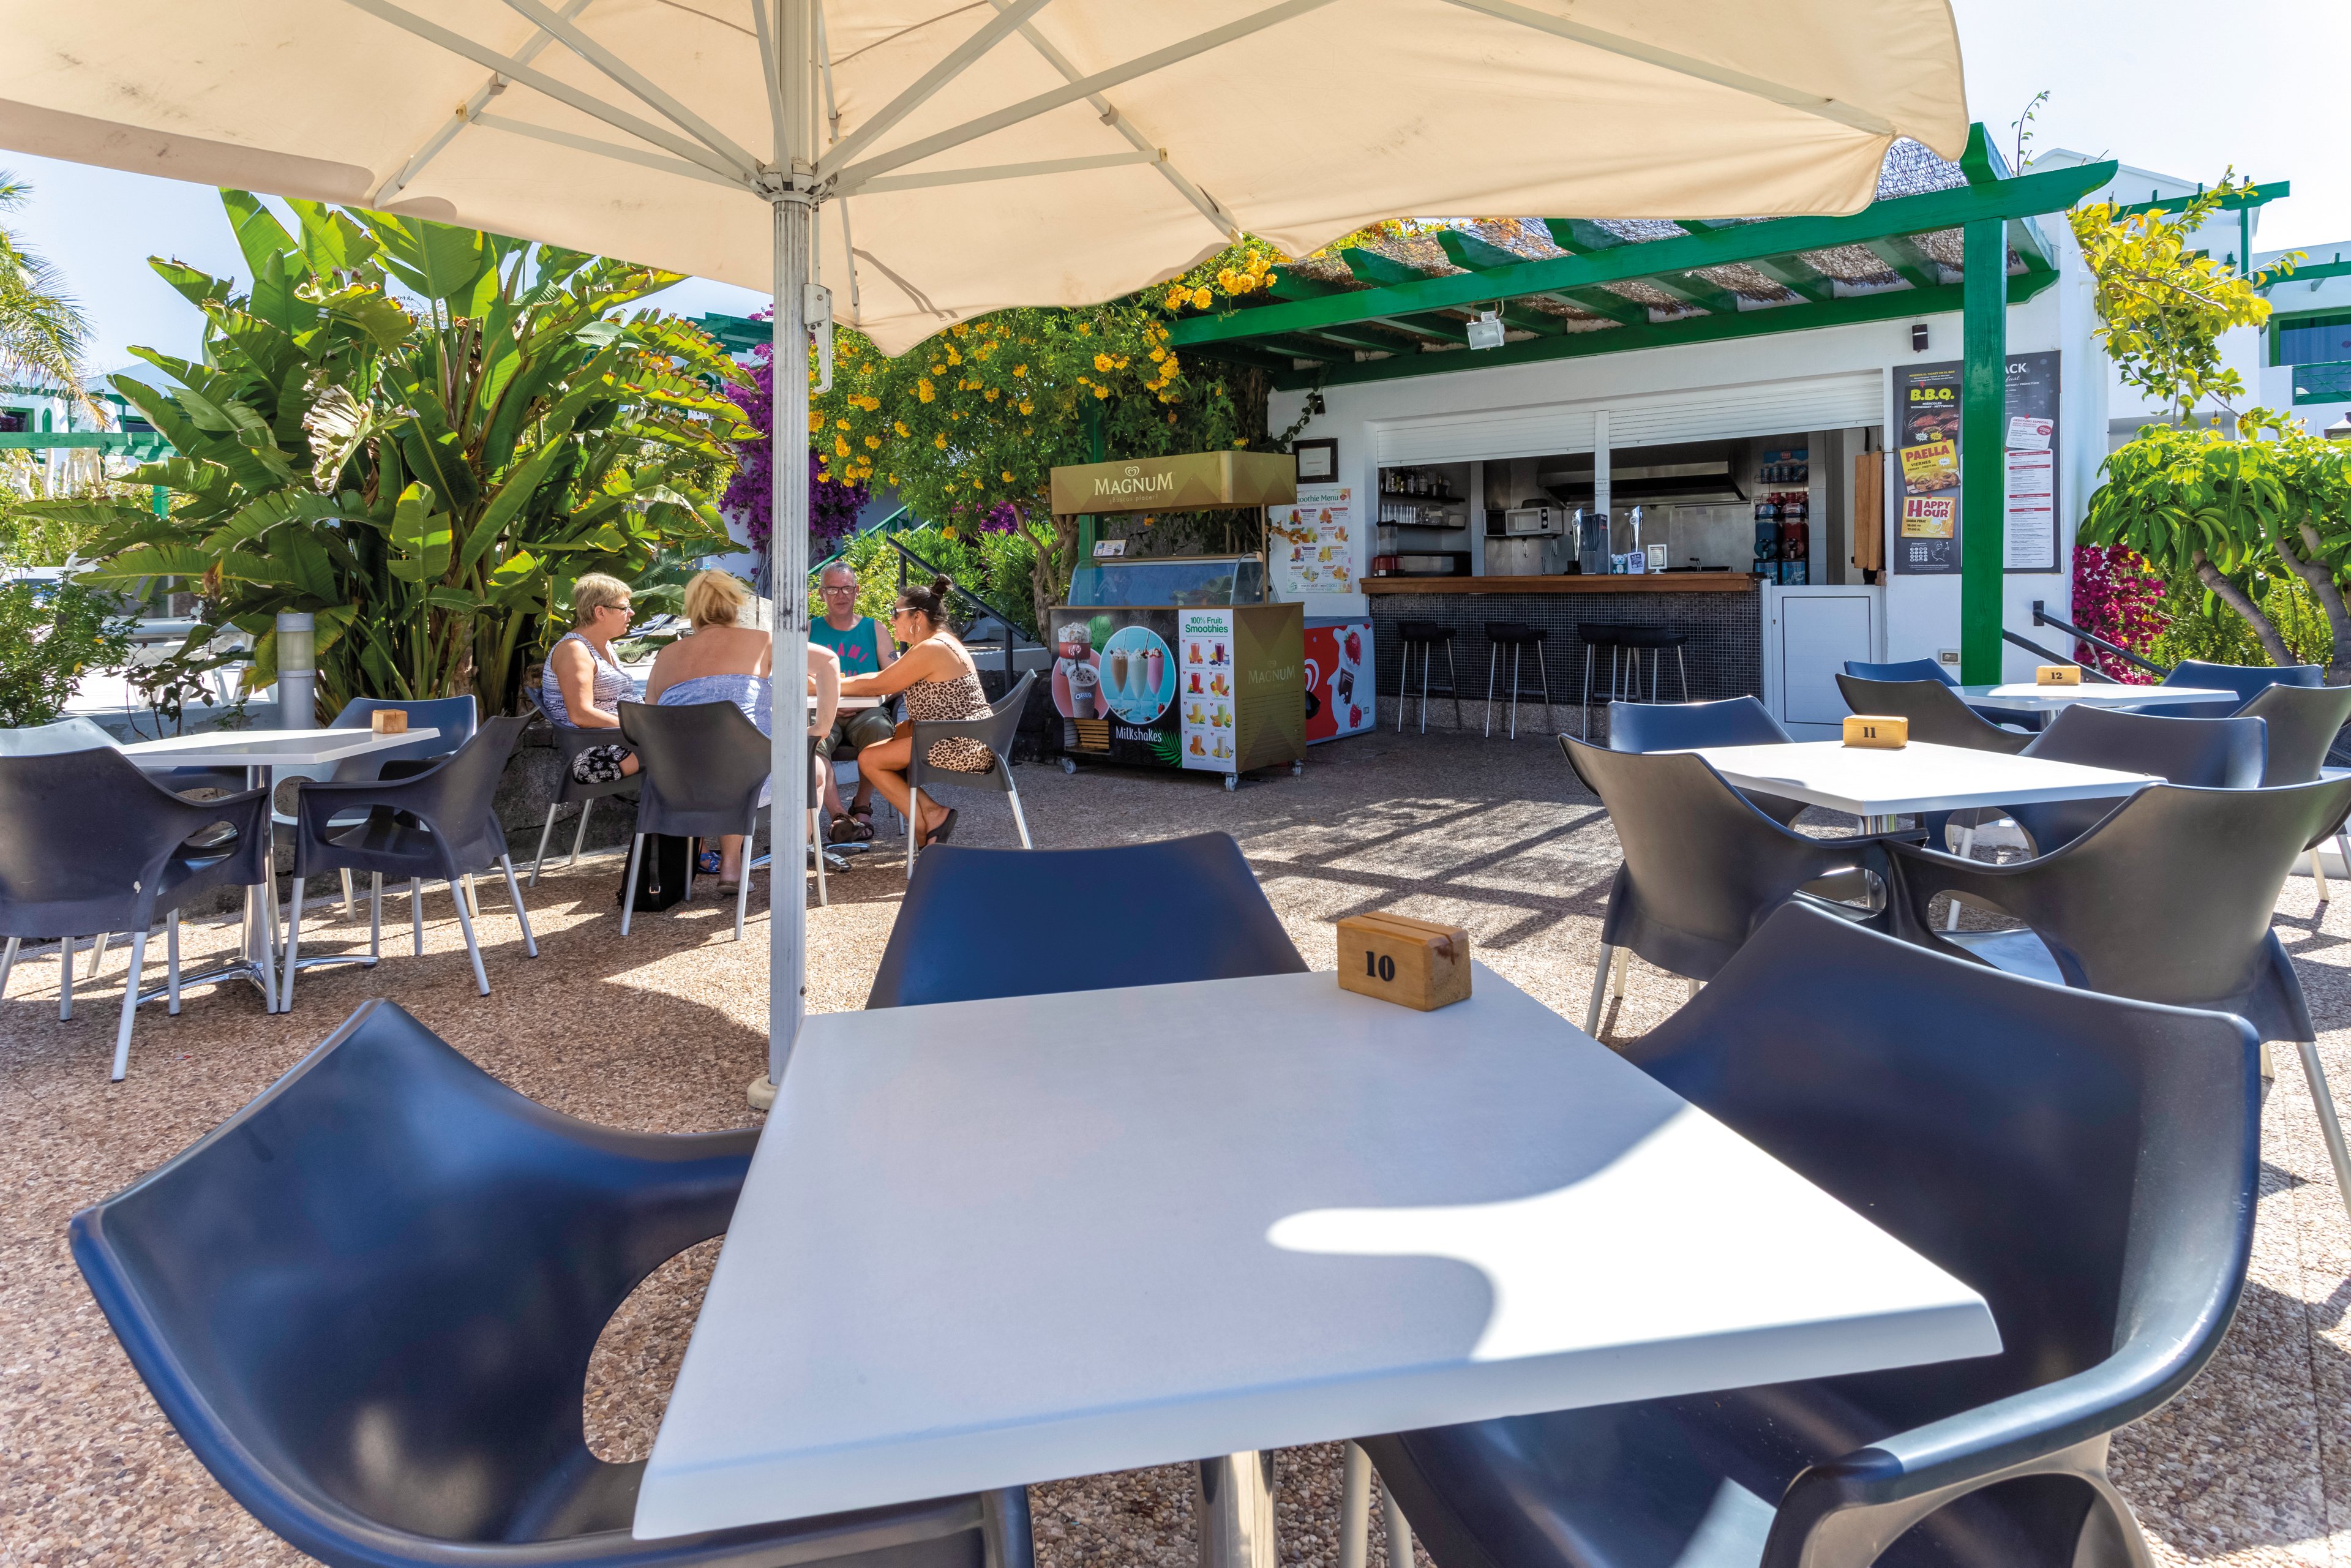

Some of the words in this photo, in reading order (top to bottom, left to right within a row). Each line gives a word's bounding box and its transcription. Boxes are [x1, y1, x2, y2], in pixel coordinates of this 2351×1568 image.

[1910, 388, 1955, 401] B.B.Q.
[1905, 445, 1950, 462] PAELLA
[1094, 471, 1174, 495] MAGNUM
[1185, 625, 1228, 633] Smoothies
[827, 642, 869, 662] AMI
[1248, 665, 1295, 685] MAGNUM
[1116, 726, 1162, 742] Milkshakes
[1863, 727, 1876, 738] 11
[1365, 951, 1395, 981] 10
